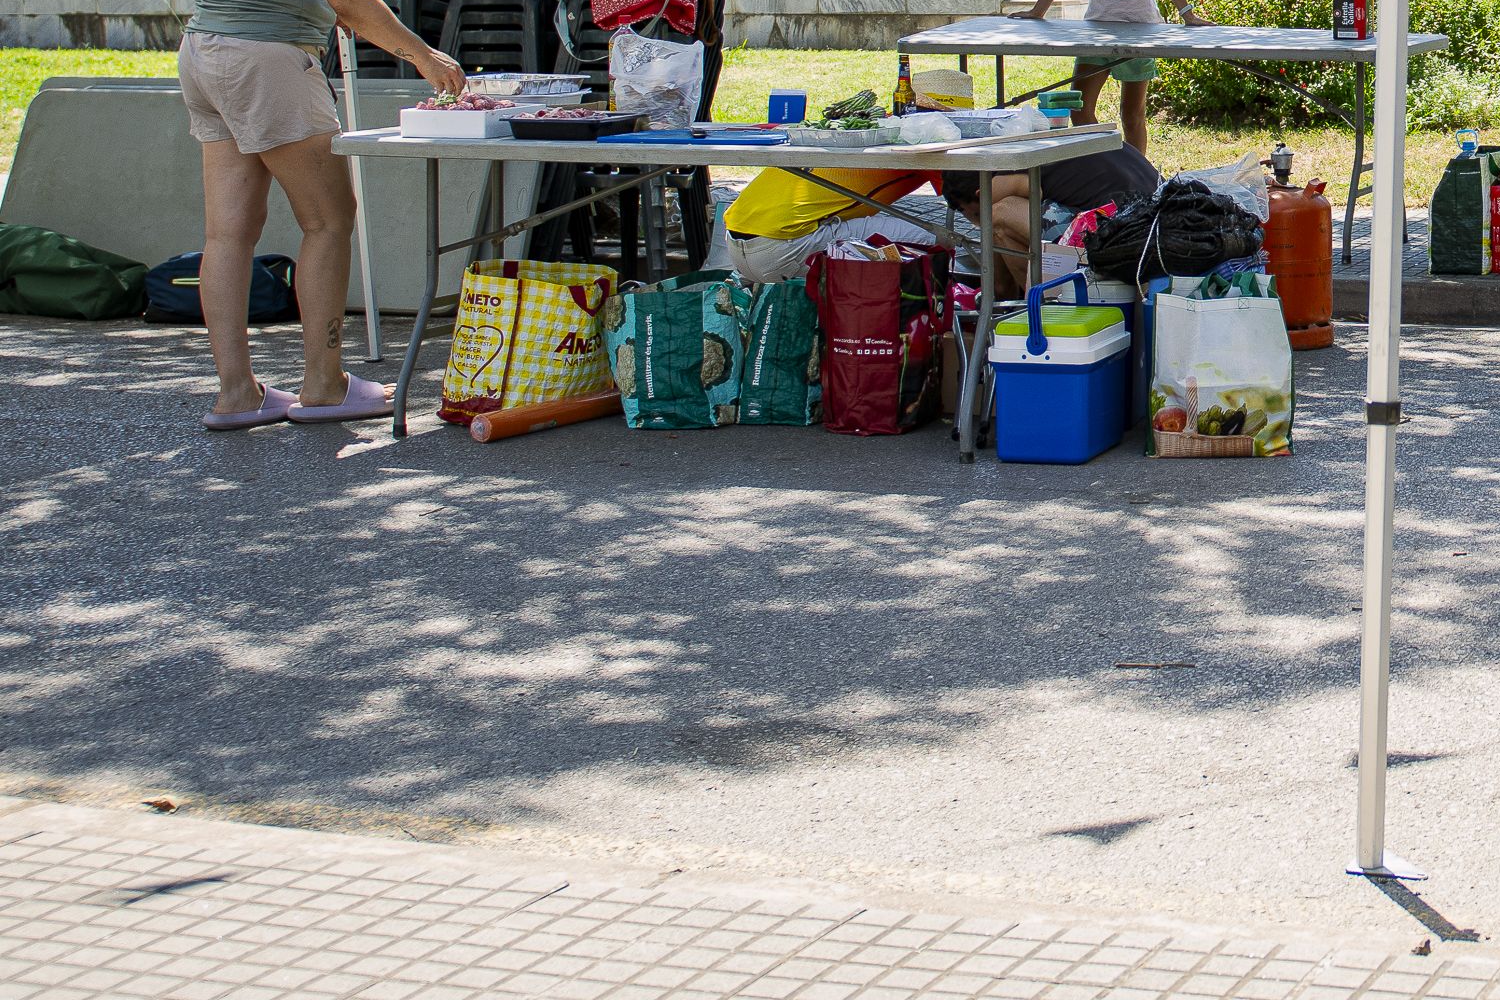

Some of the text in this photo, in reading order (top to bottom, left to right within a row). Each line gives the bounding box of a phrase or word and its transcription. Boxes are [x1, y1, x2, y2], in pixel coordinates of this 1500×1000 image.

[762, 324, 770, 335] de
[646, 336, 653, 346] de
[759, 335, 767, 344] és
[467, 354, 485, 362] BUEN
[752, 344, 765, 386] Reutilitzar
[645, 356, 654, 399] Reutilitzar
